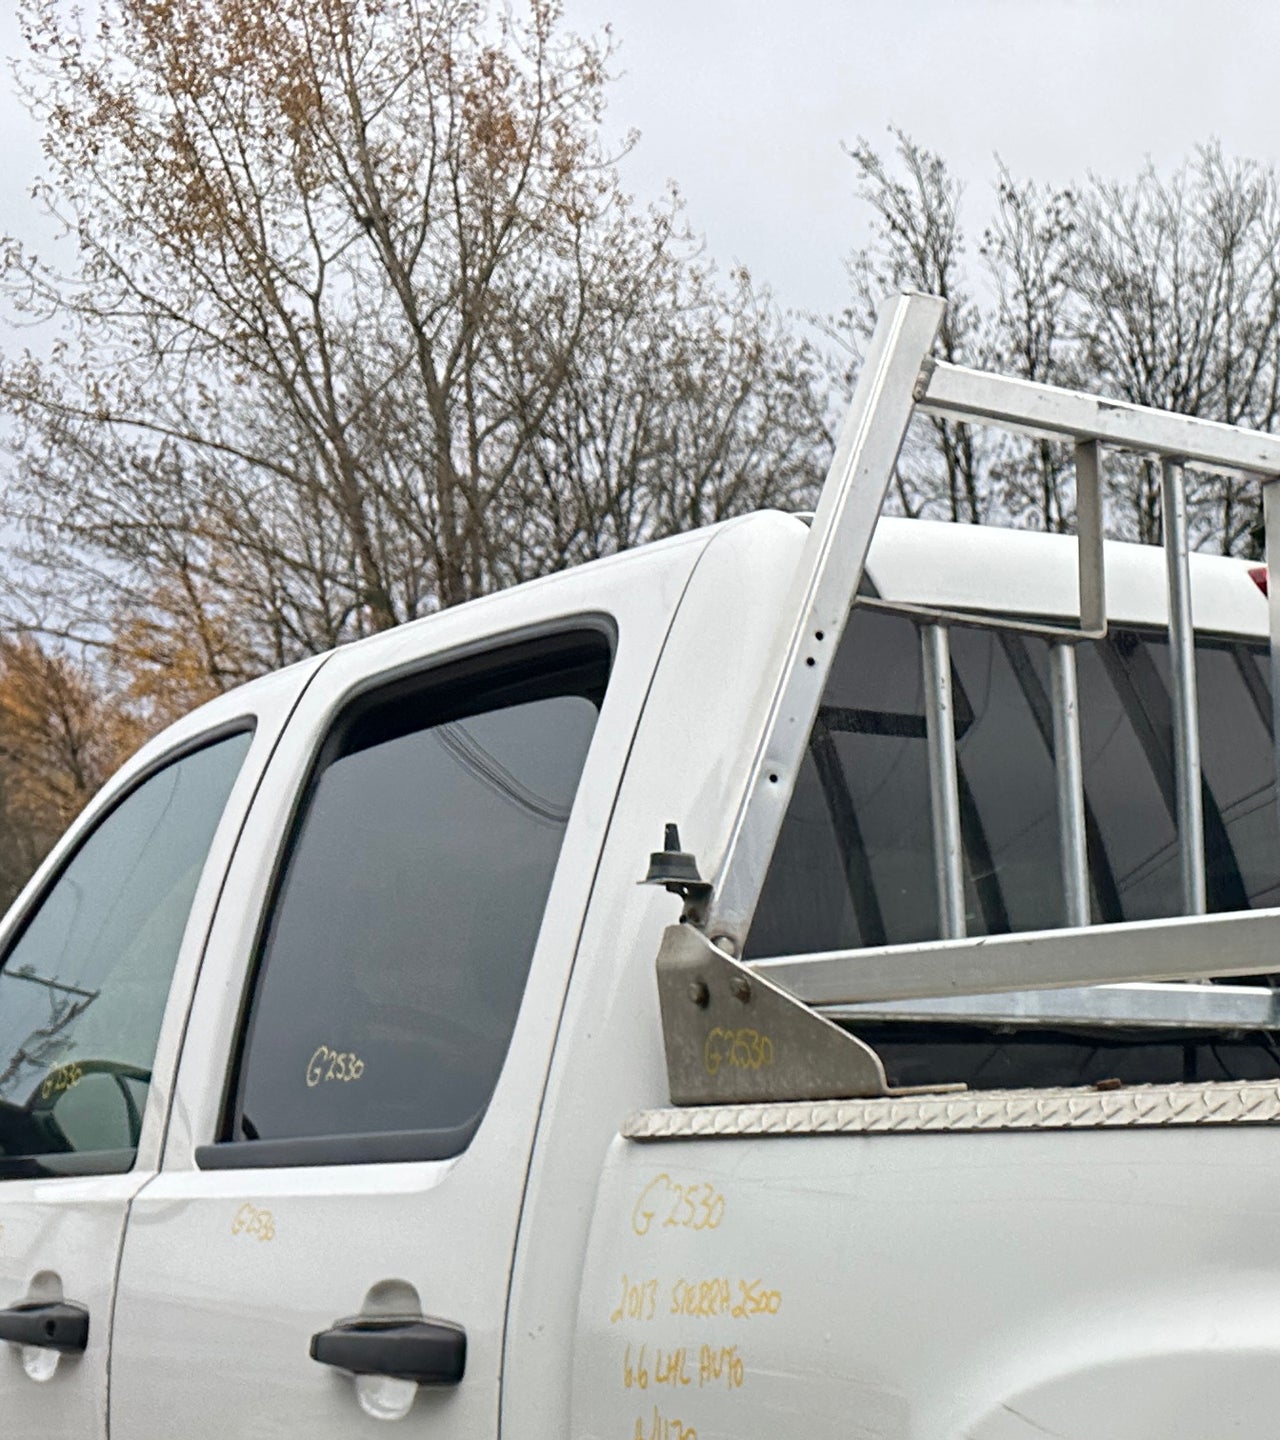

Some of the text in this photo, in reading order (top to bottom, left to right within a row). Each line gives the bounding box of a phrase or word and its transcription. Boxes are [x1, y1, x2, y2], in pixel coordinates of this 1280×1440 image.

[306, 1045, 364, 1087] G2530
[704, 1027, 774, 1075] G2530
[632, 1173, 725, 1236] G2530
